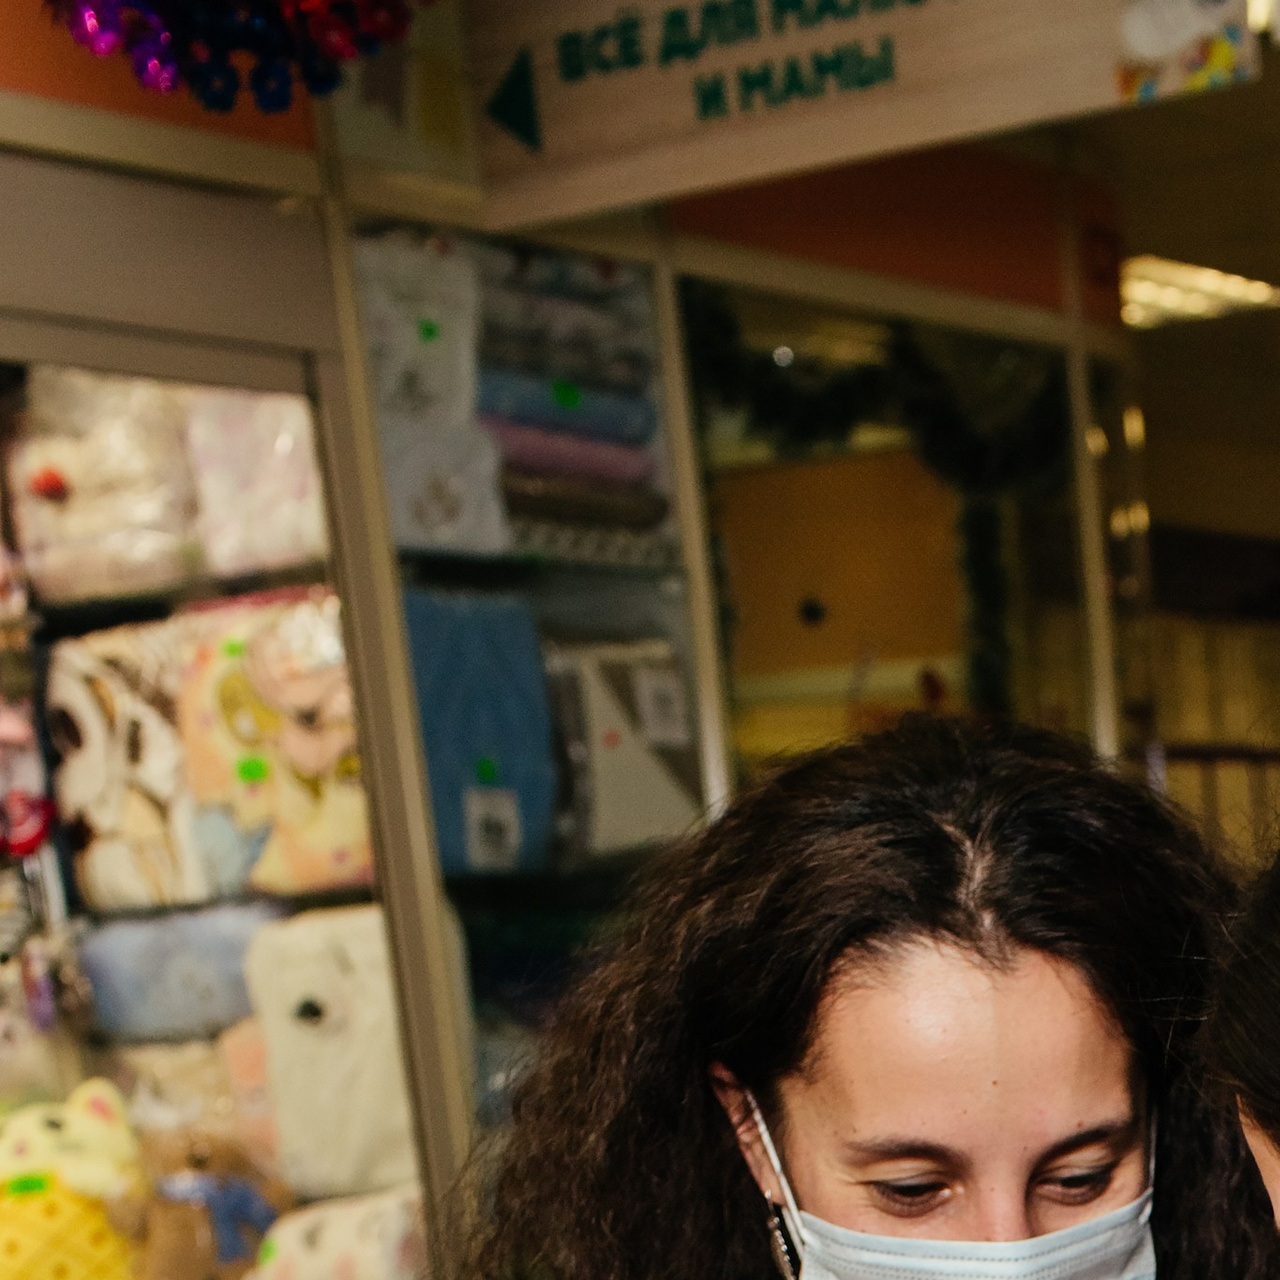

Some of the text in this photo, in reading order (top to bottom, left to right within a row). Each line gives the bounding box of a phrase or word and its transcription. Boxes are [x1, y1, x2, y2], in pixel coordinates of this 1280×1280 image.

[658, 0, 760, 68] ДЛЯ
[694, 33, 896, 120] И МАМЫ
